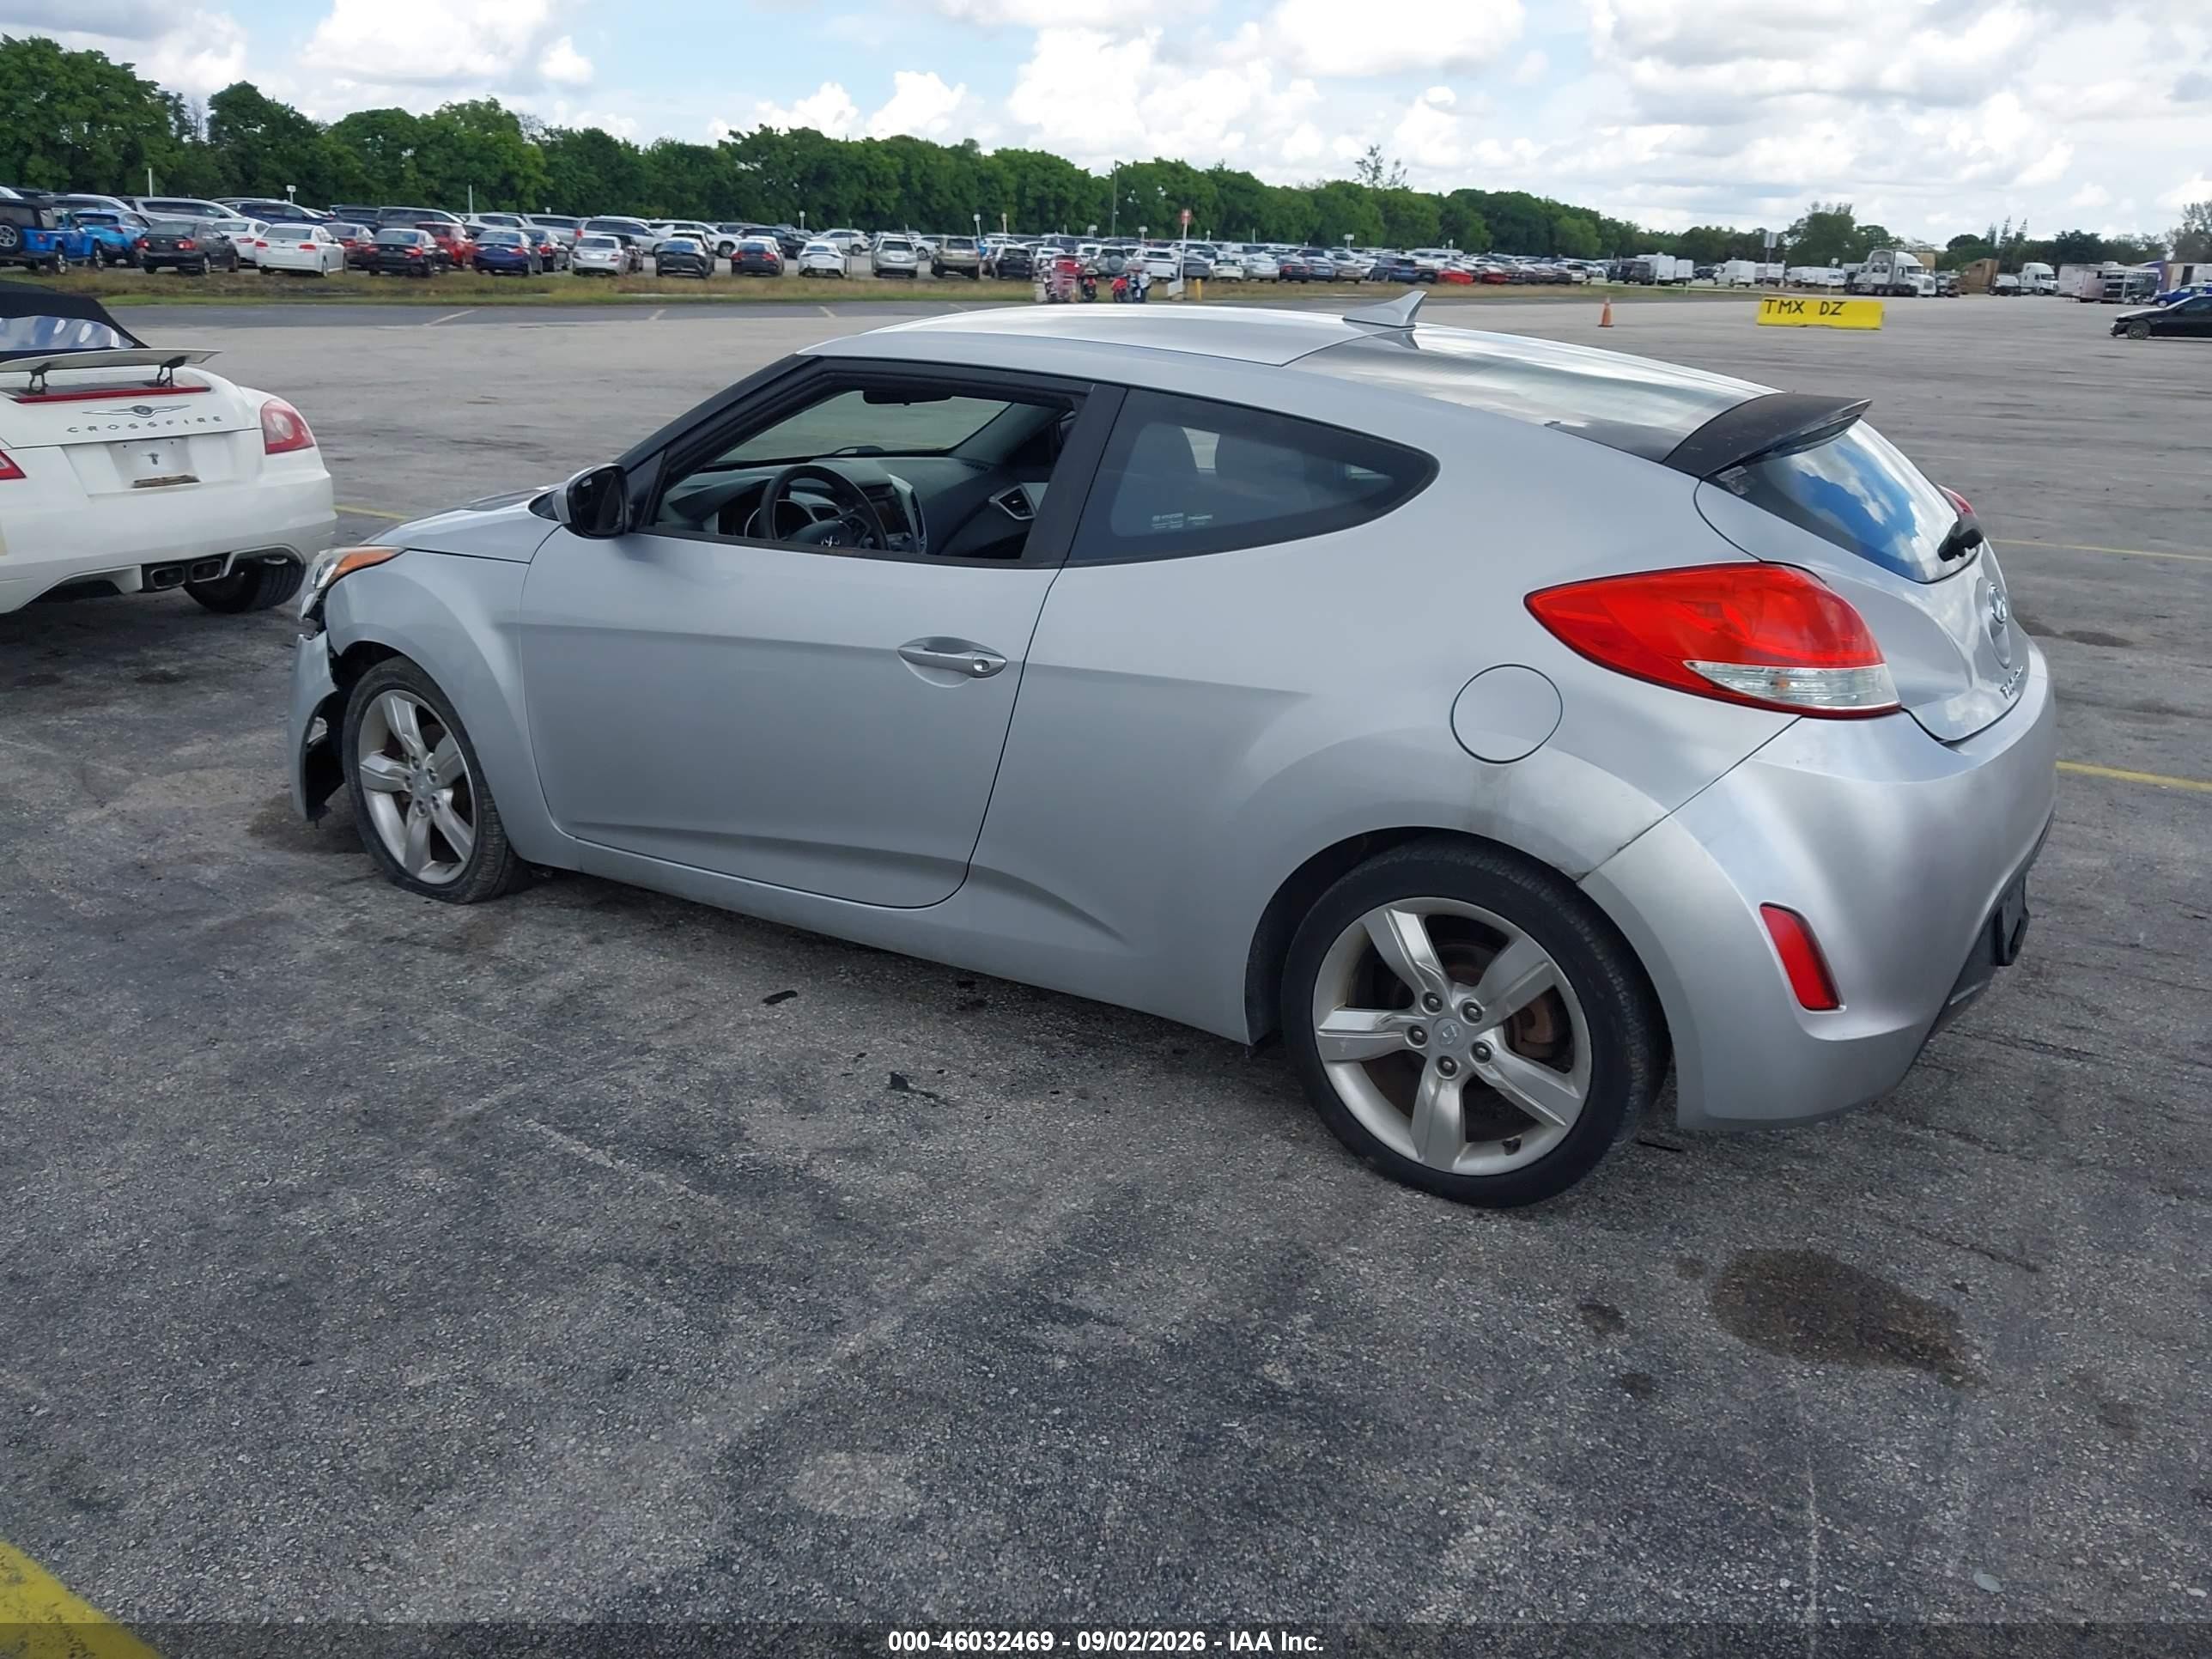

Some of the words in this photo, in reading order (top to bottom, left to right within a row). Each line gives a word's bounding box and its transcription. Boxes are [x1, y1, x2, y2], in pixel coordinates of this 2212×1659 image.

[1764, 299, 1805, 314] TMX
[1819, 301, 1847, 316] DZ
[67, 416, 222, 433] CROSSFIRE
